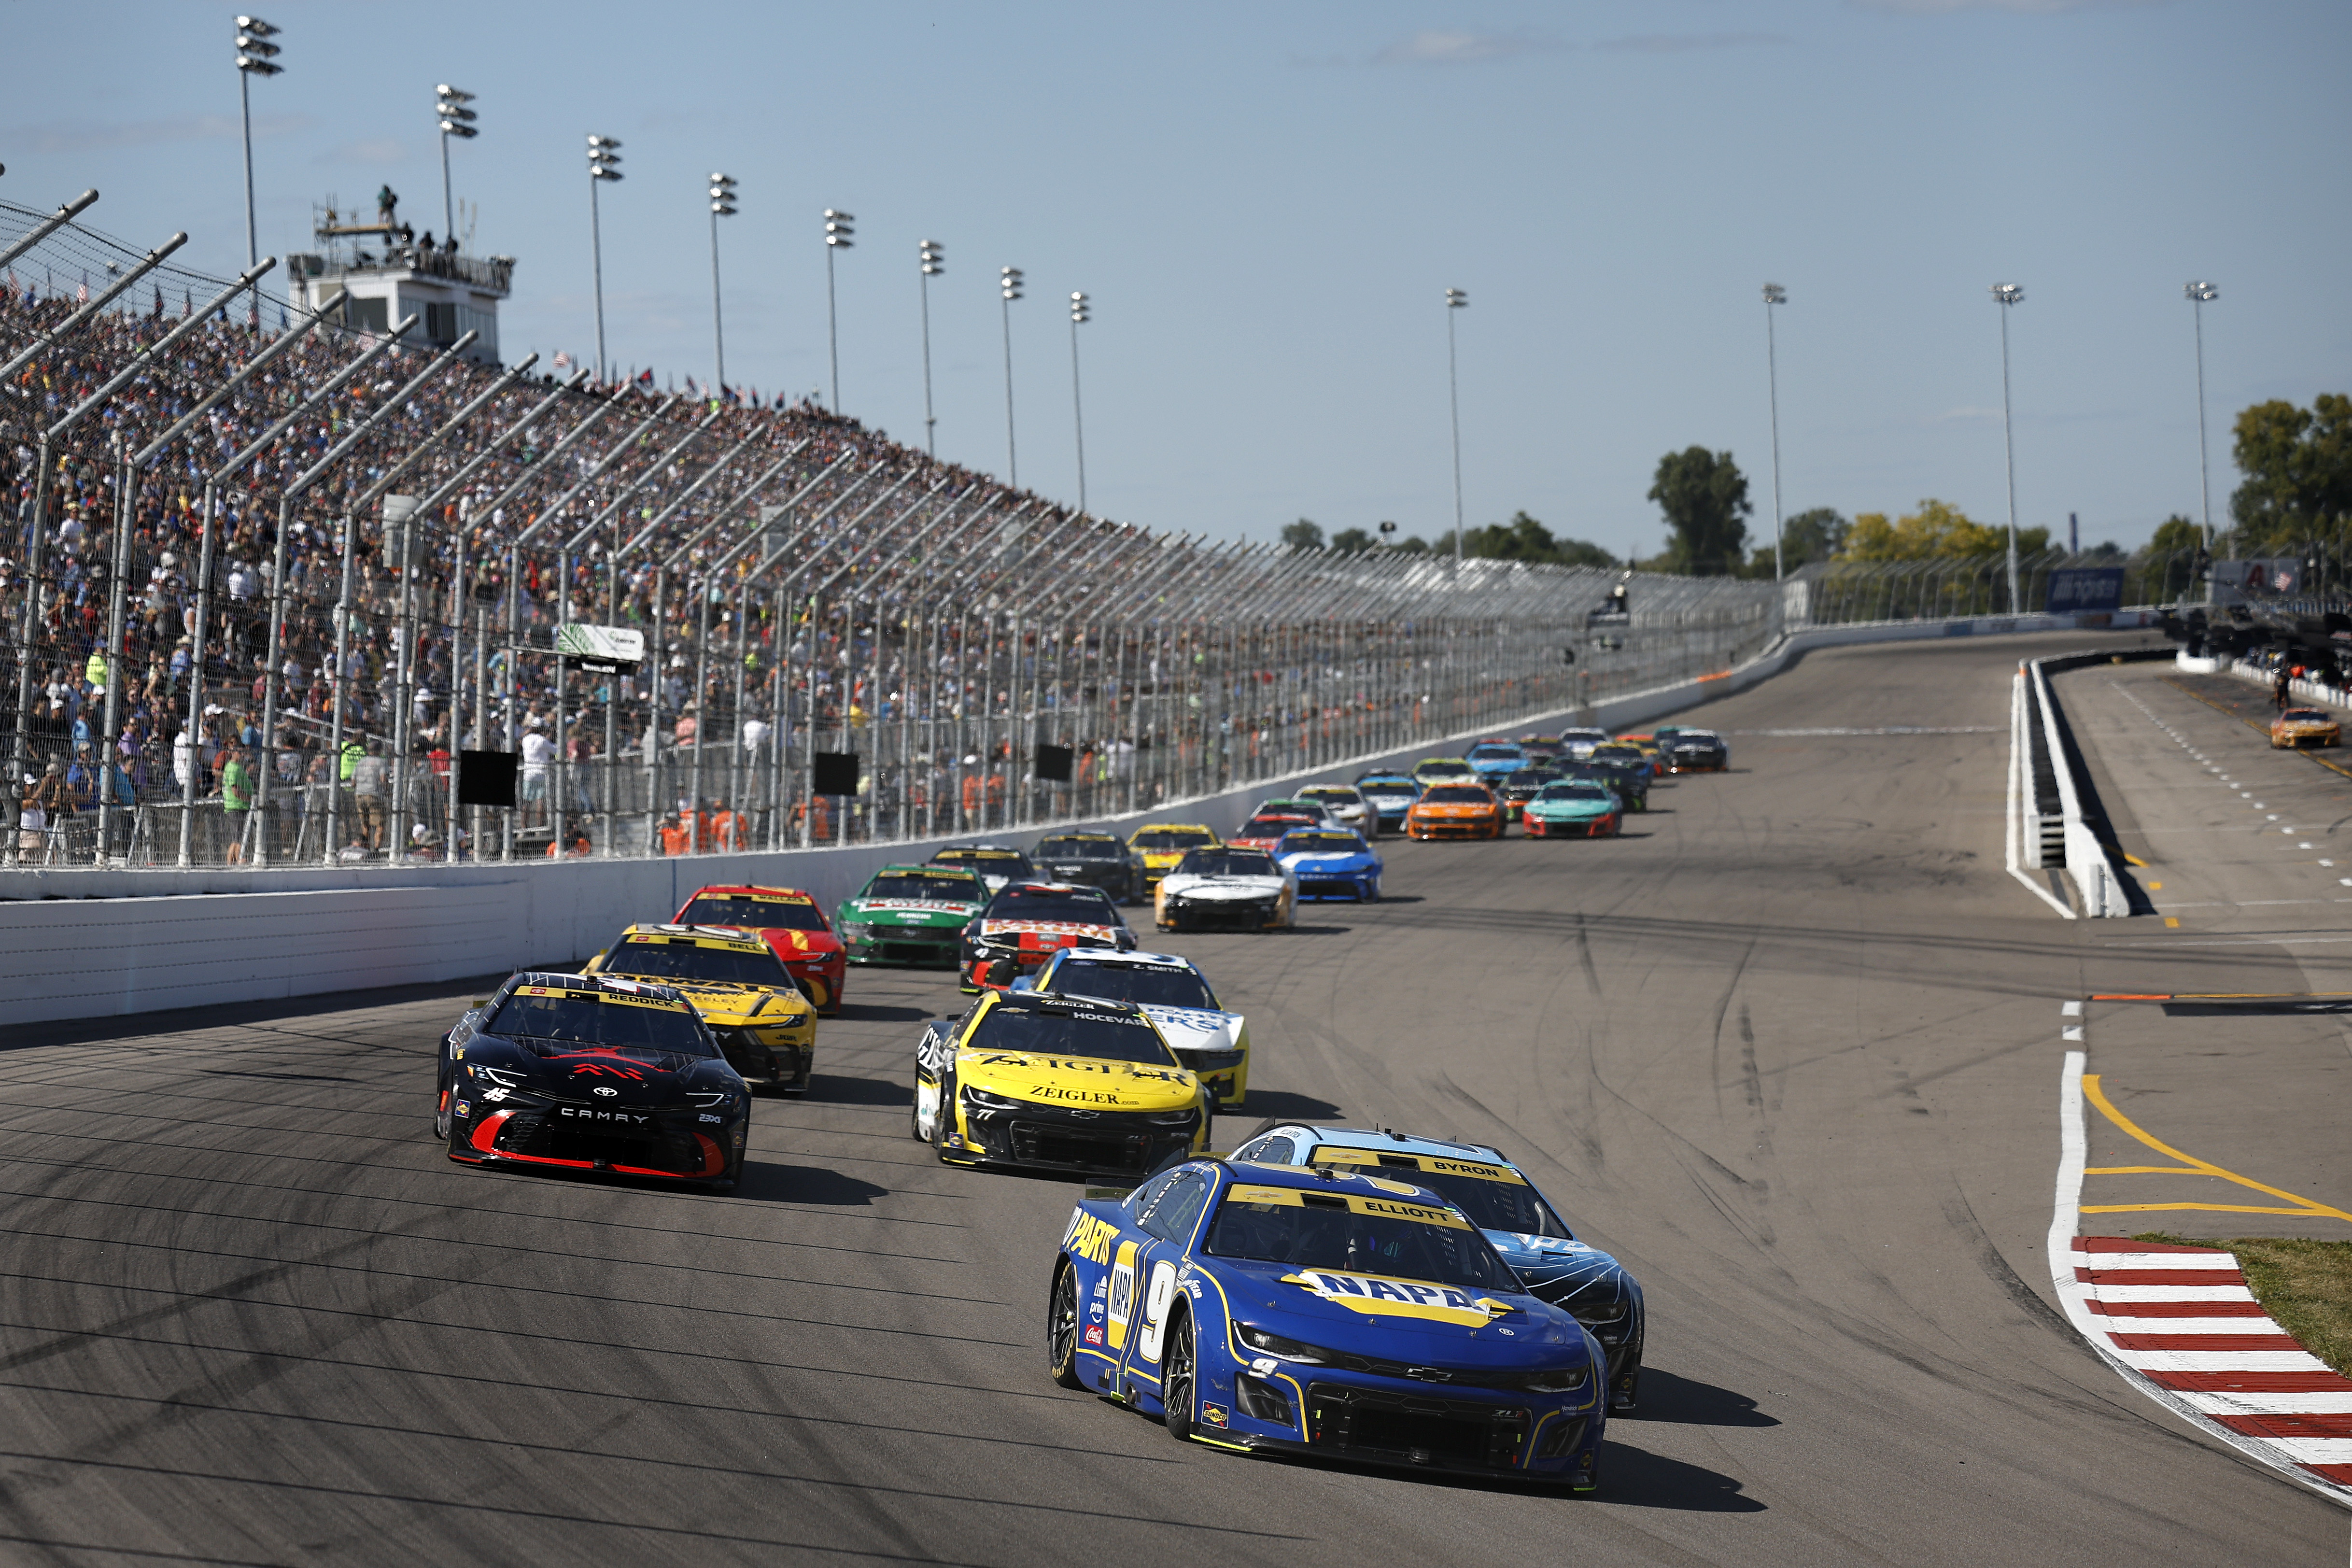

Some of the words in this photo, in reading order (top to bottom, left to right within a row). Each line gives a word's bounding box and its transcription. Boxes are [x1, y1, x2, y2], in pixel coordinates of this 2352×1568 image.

[729, 942, 759, 951] BELL
[608, 994, 675, 1008] REDDICK
[1045, 1000, 1095, 1010] ZEIGLER
[1073, 1012, 1145, 1027] HOCEVAR
[482, 1087, 510, 1102] 45
[561, 1108, 649, 1124] CAMRY
[976, 1109, 996, 1121] 77
[1434, 1161, 1500, 1177] BYRON
[1365, 1201, 1448, 1222] ELLIOTT
[1066, 1211, 1121, 1266] PARTS
[1111, 1269, 1131, 1319] NAPA
[1316, 1274, 1486, 1312] NAPA
[1140, 1259, 1177, 1364] 9
[1248, 1358, 1279, 1379] 9
[1204, 1410, 1227, 1420] SUNOCO
[1491, 1409, 1524, 1418] ZL1
